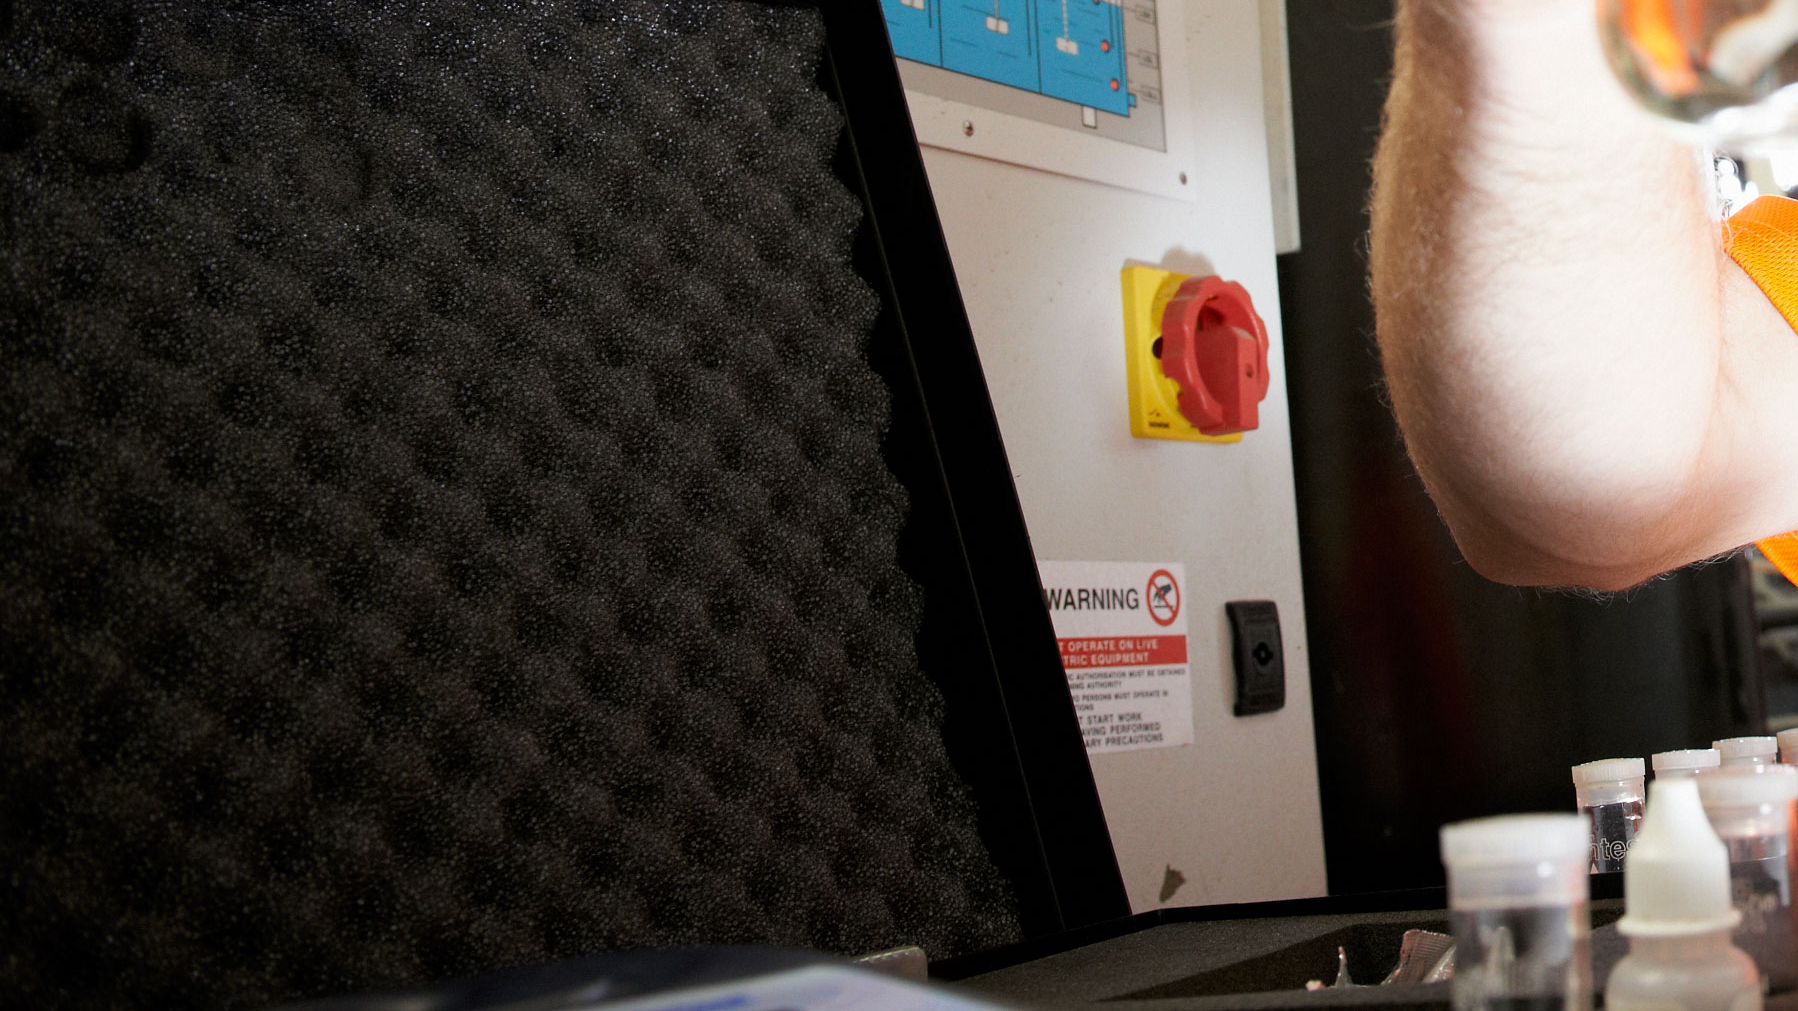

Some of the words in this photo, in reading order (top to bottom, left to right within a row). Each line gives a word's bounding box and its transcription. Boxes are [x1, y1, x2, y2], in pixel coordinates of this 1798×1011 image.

[1048, 588, 1139, 610] WARNING
[1067, 640, 1115, 653] OPERATE
[1119, 639, 1134, 650] ON
[1137, 638, 1158, 650] LIVE
[1091, 652, 1150, 665] EQUIPMENT
[1128, 669, 1145, 677] MUST
[1087, 680, 1122, 690] AUTHORITY
[1082, 693, 1112, 702] PERSONS
[1114, 692, 1131, 700] MUST
[1133, 690, 1160, 699] OPERATE
[1087, 714, 1114, 725] START
[1118, 712, 1142, 722] WORK
[1110, 722, 1161, 734] PERFORMED
[1105, 733, 1164, 747] PRECAUTIONS
